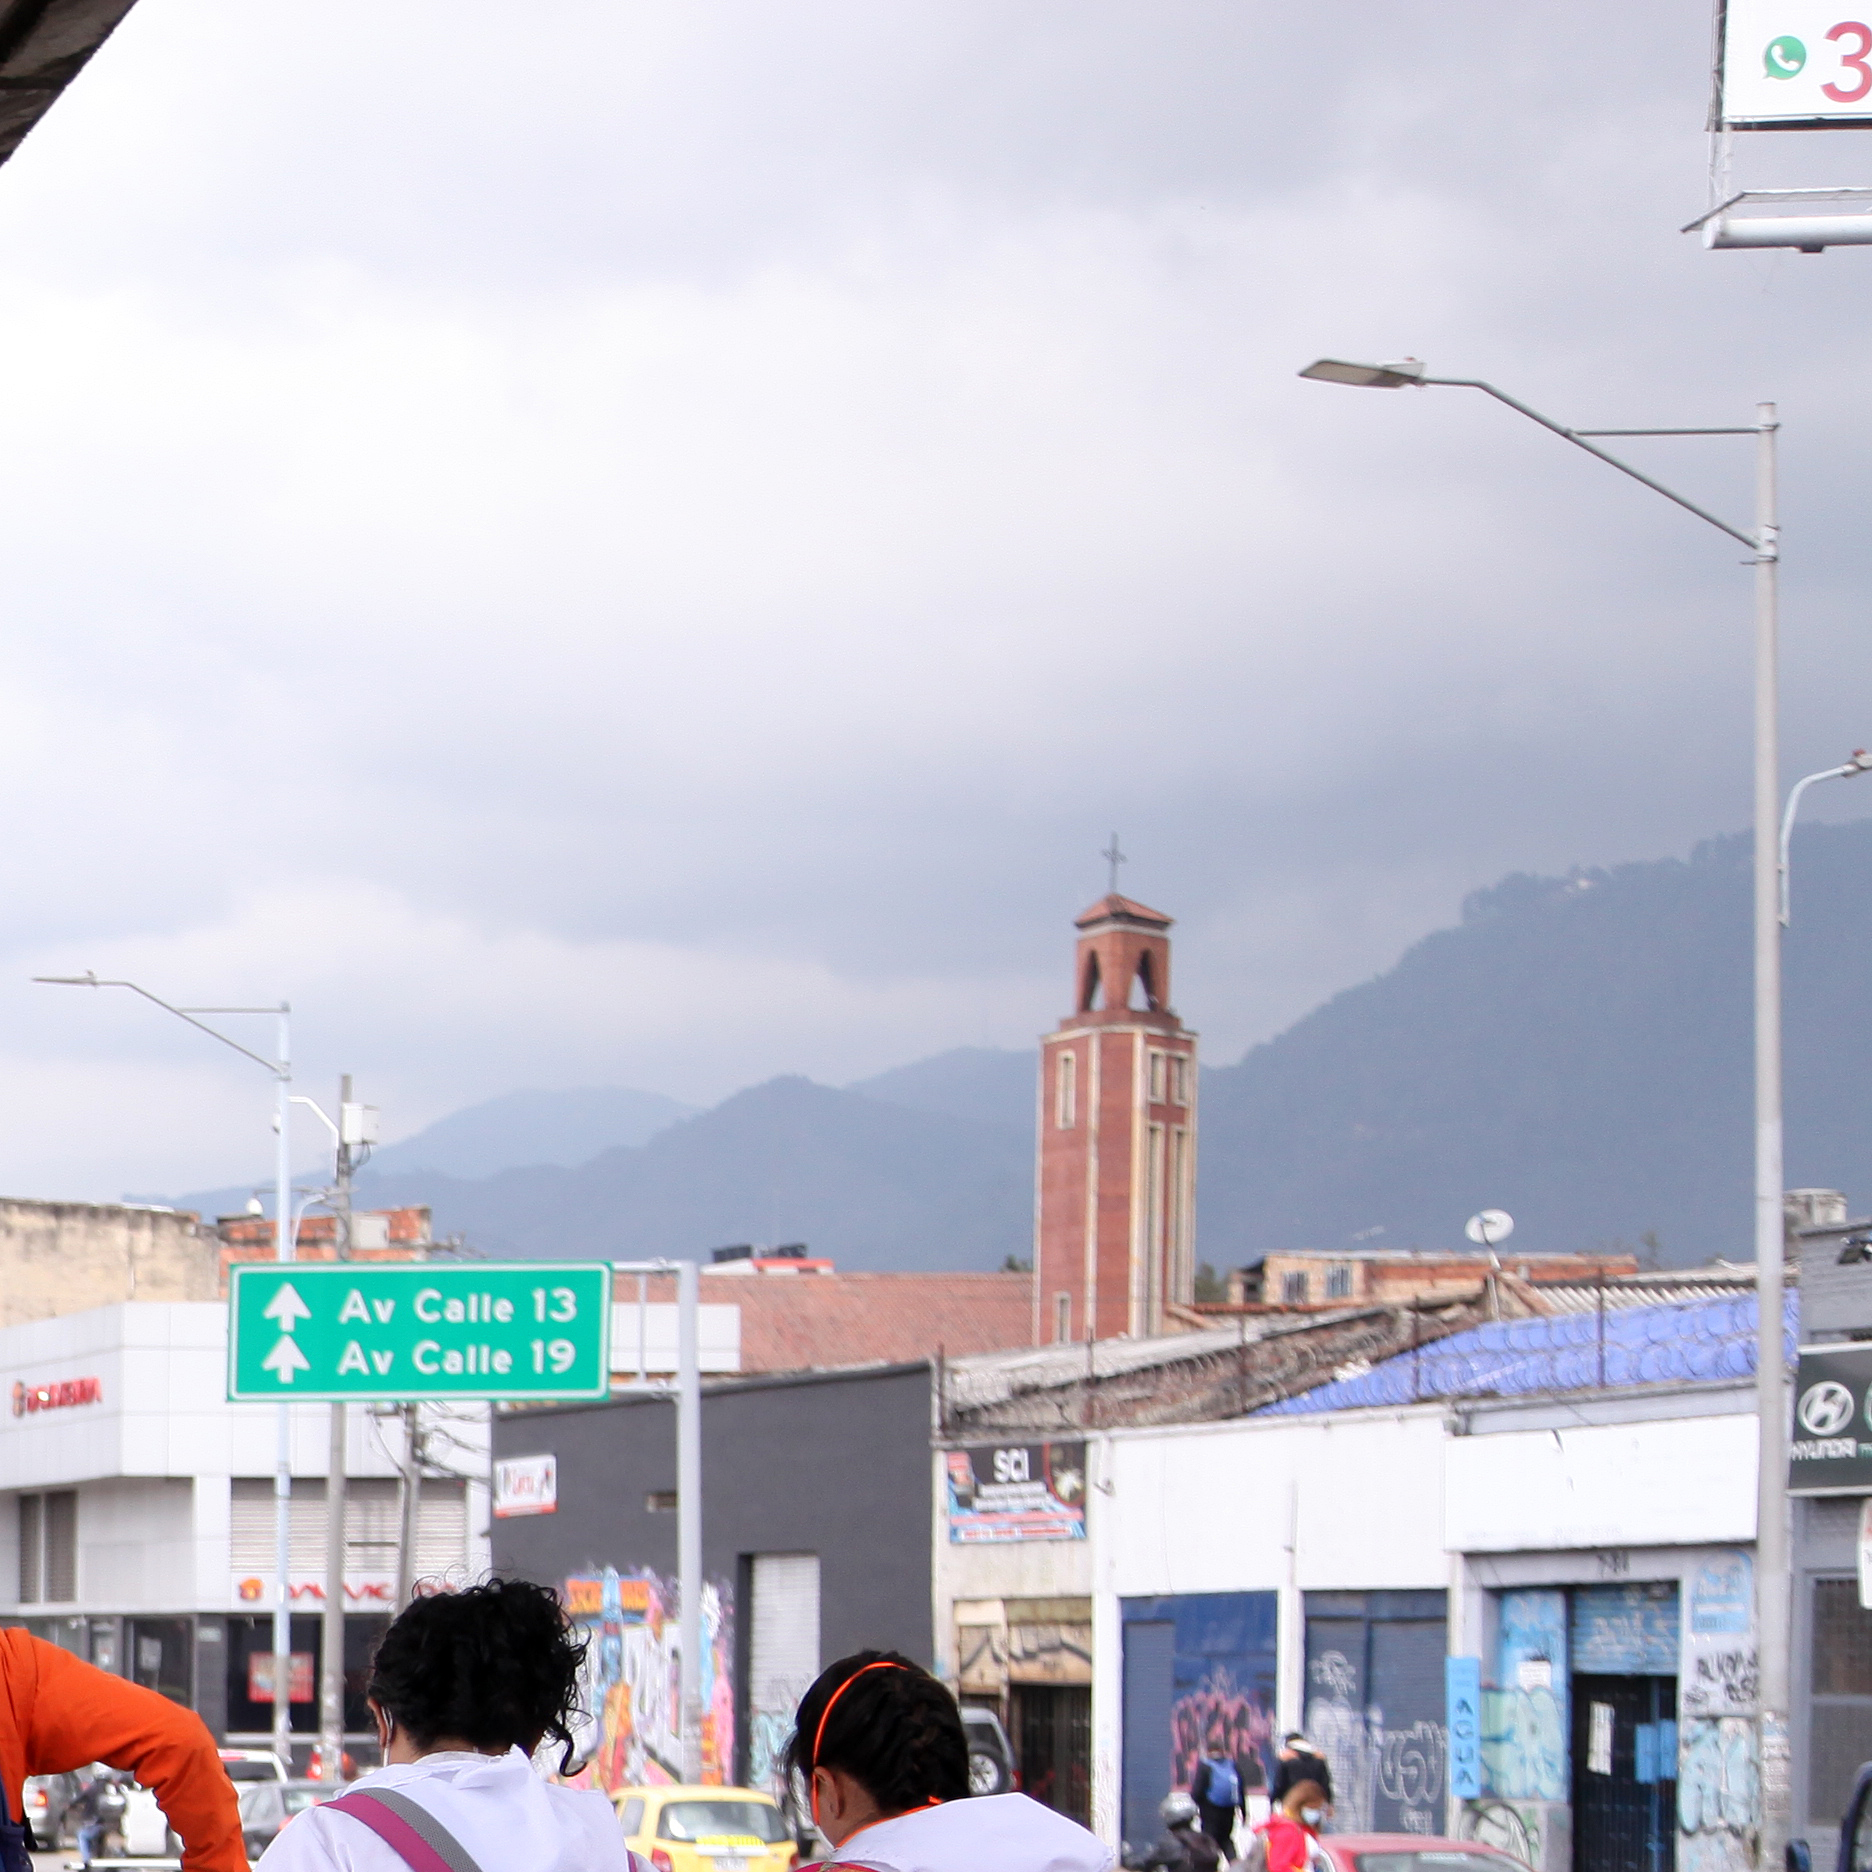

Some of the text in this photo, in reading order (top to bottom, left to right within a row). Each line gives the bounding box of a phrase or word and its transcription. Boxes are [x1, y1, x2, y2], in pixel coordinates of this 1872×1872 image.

[337, 1287, 578, 1325] Av Calle 13
[336, 1338, 576, 1375] Av Calle 19
